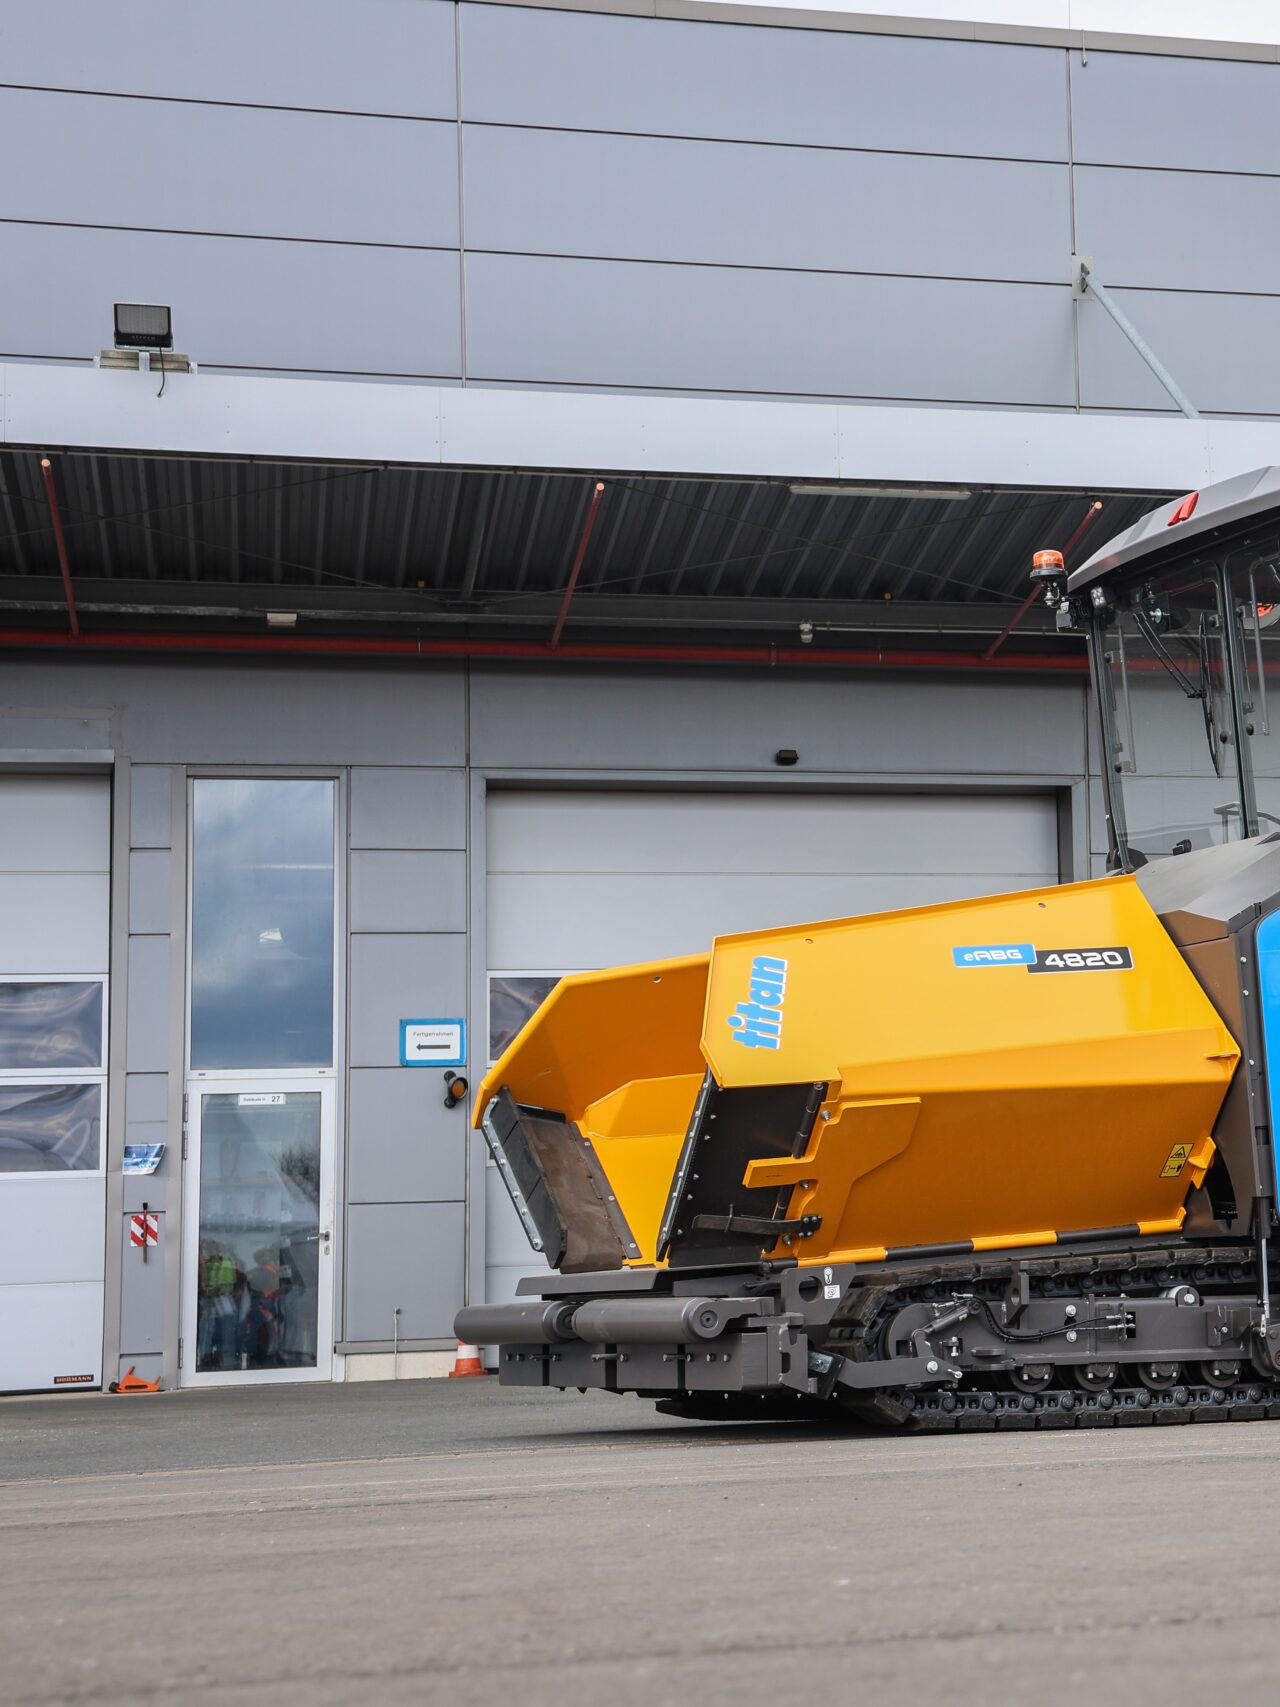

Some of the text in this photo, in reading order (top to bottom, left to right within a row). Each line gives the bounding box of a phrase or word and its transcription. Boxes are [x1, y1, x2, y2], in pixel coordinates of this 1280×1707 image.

[963, 949, 1124, 967] eABG 4820
[727, 955, 788, 1050] titan
